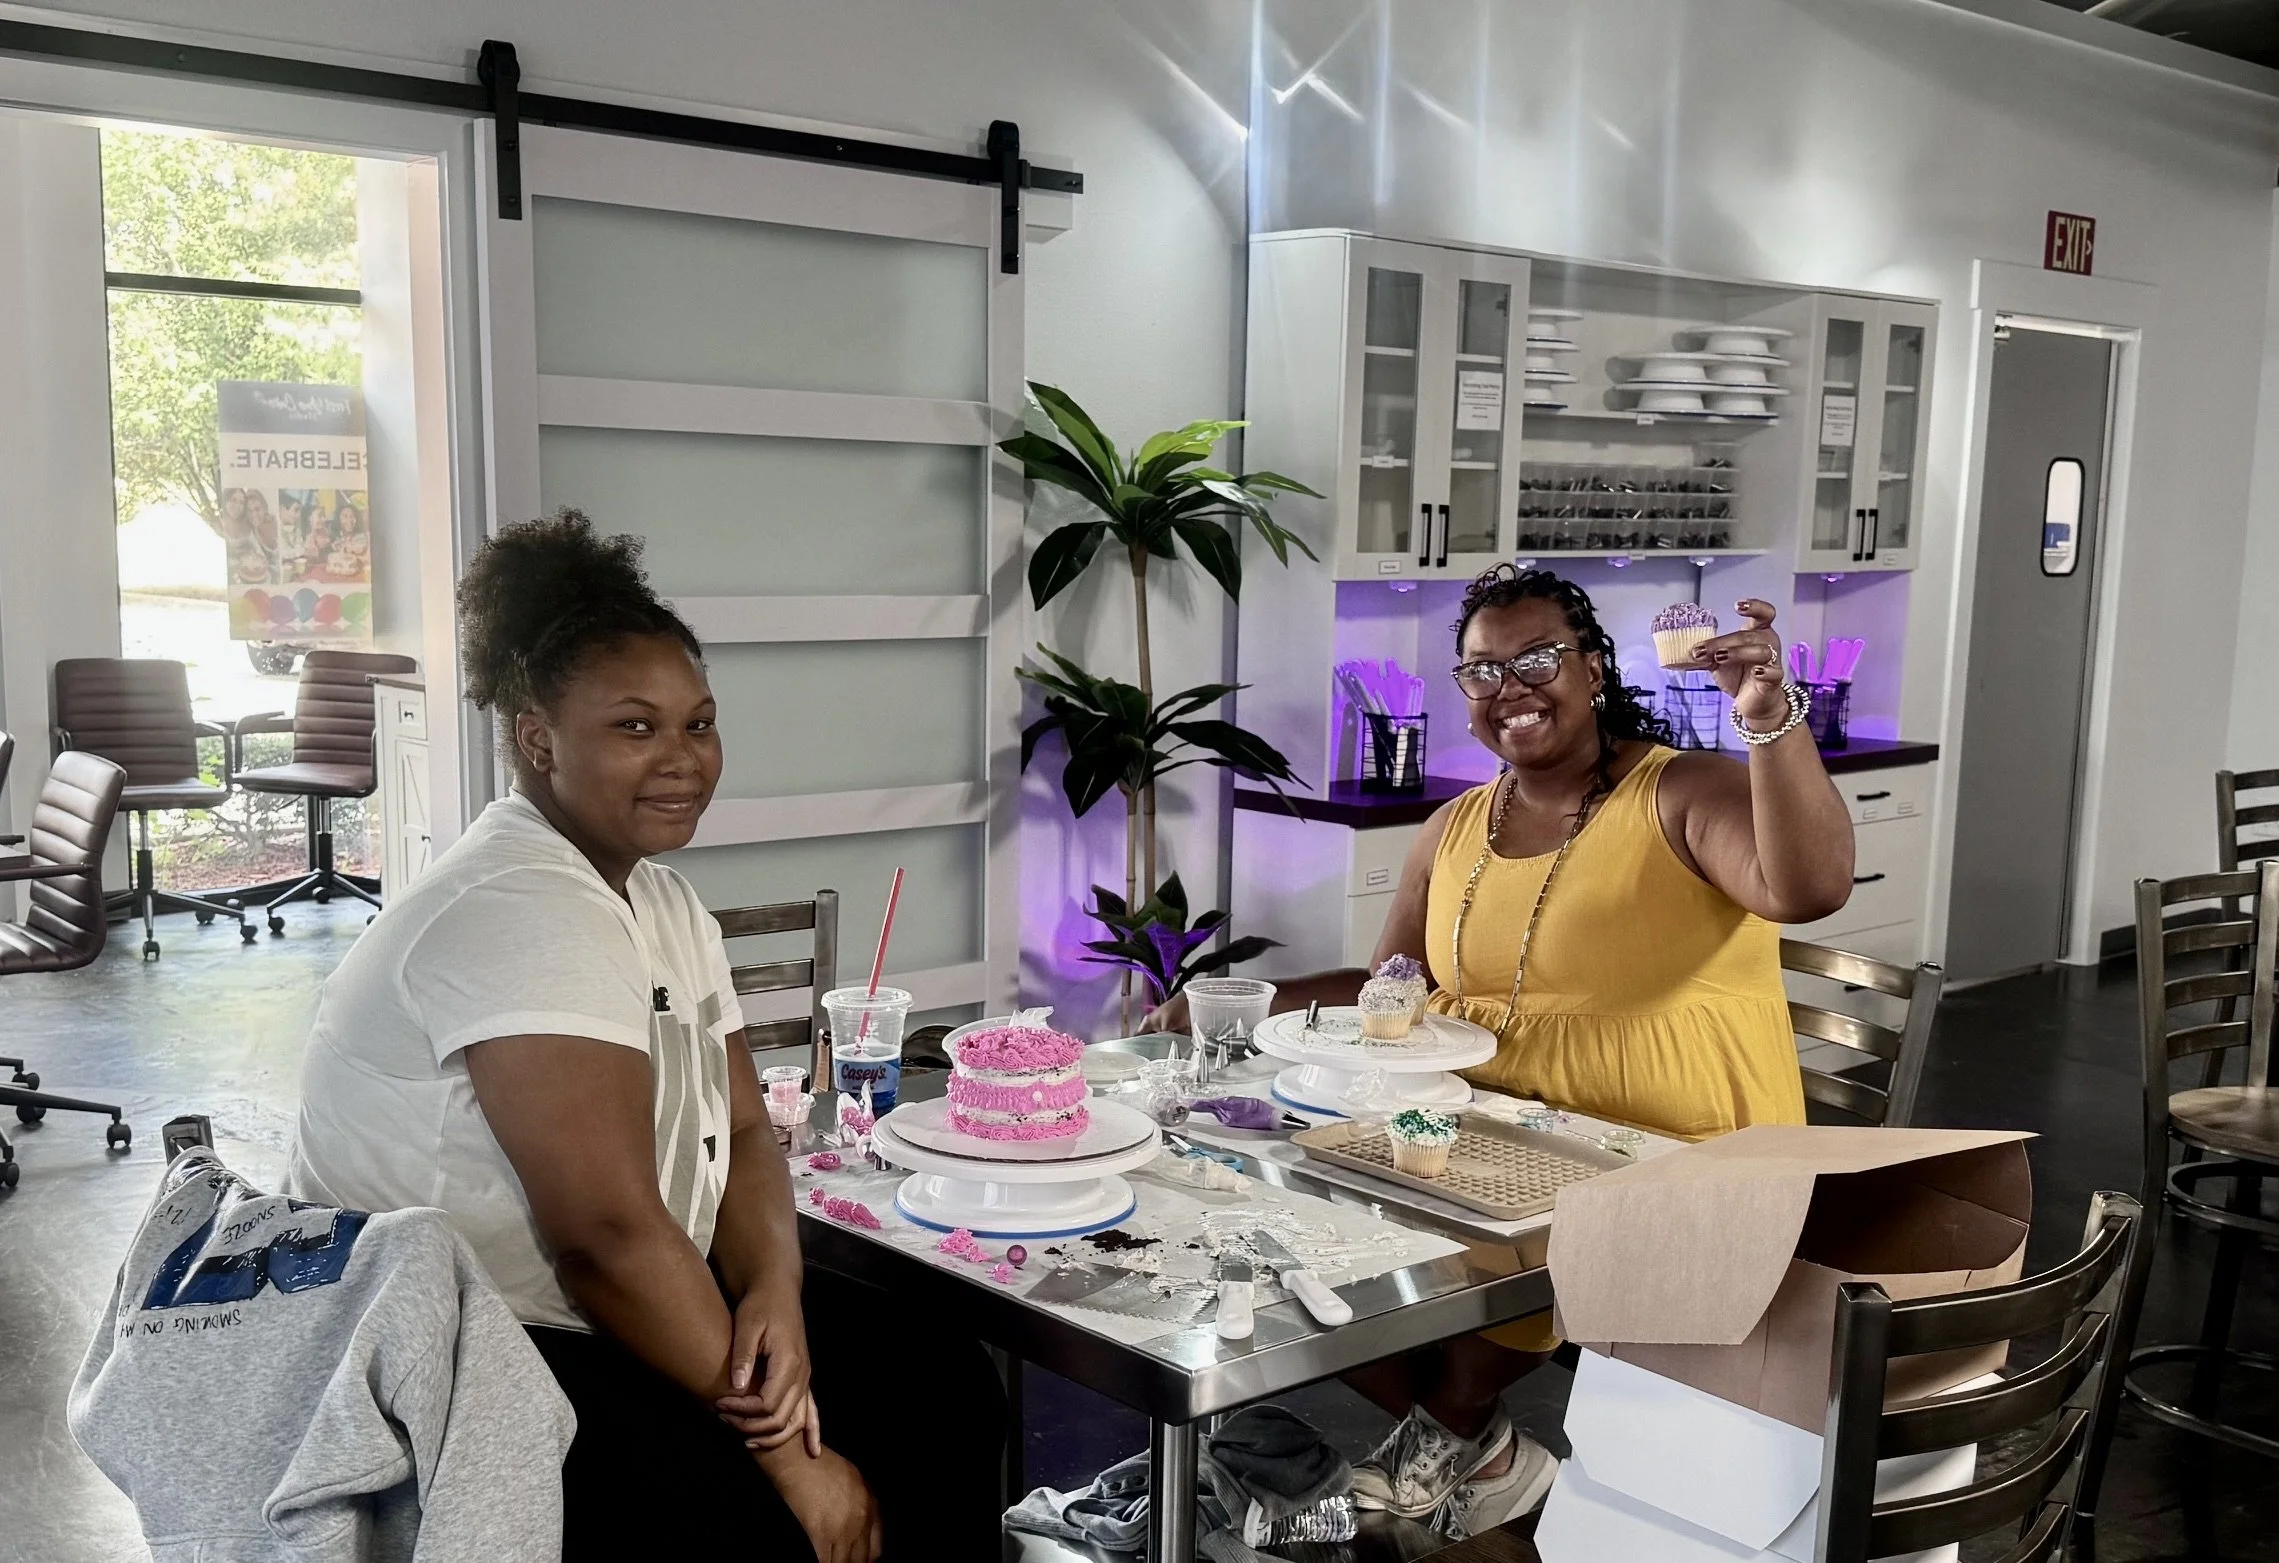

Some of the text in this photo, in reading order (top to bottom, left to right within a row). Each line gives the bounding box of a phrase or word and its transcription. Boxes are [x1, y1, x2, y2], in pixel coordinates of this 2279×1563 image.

[2051, 215, 2092, 273] EXIT
[841, 1063, 887, 1084] Casey's
[221, 1205, 276, 1245] SNOOZE
[142, 1320, 164, 1337] ON
[172, 1309, 242, 1335] SMOKING
